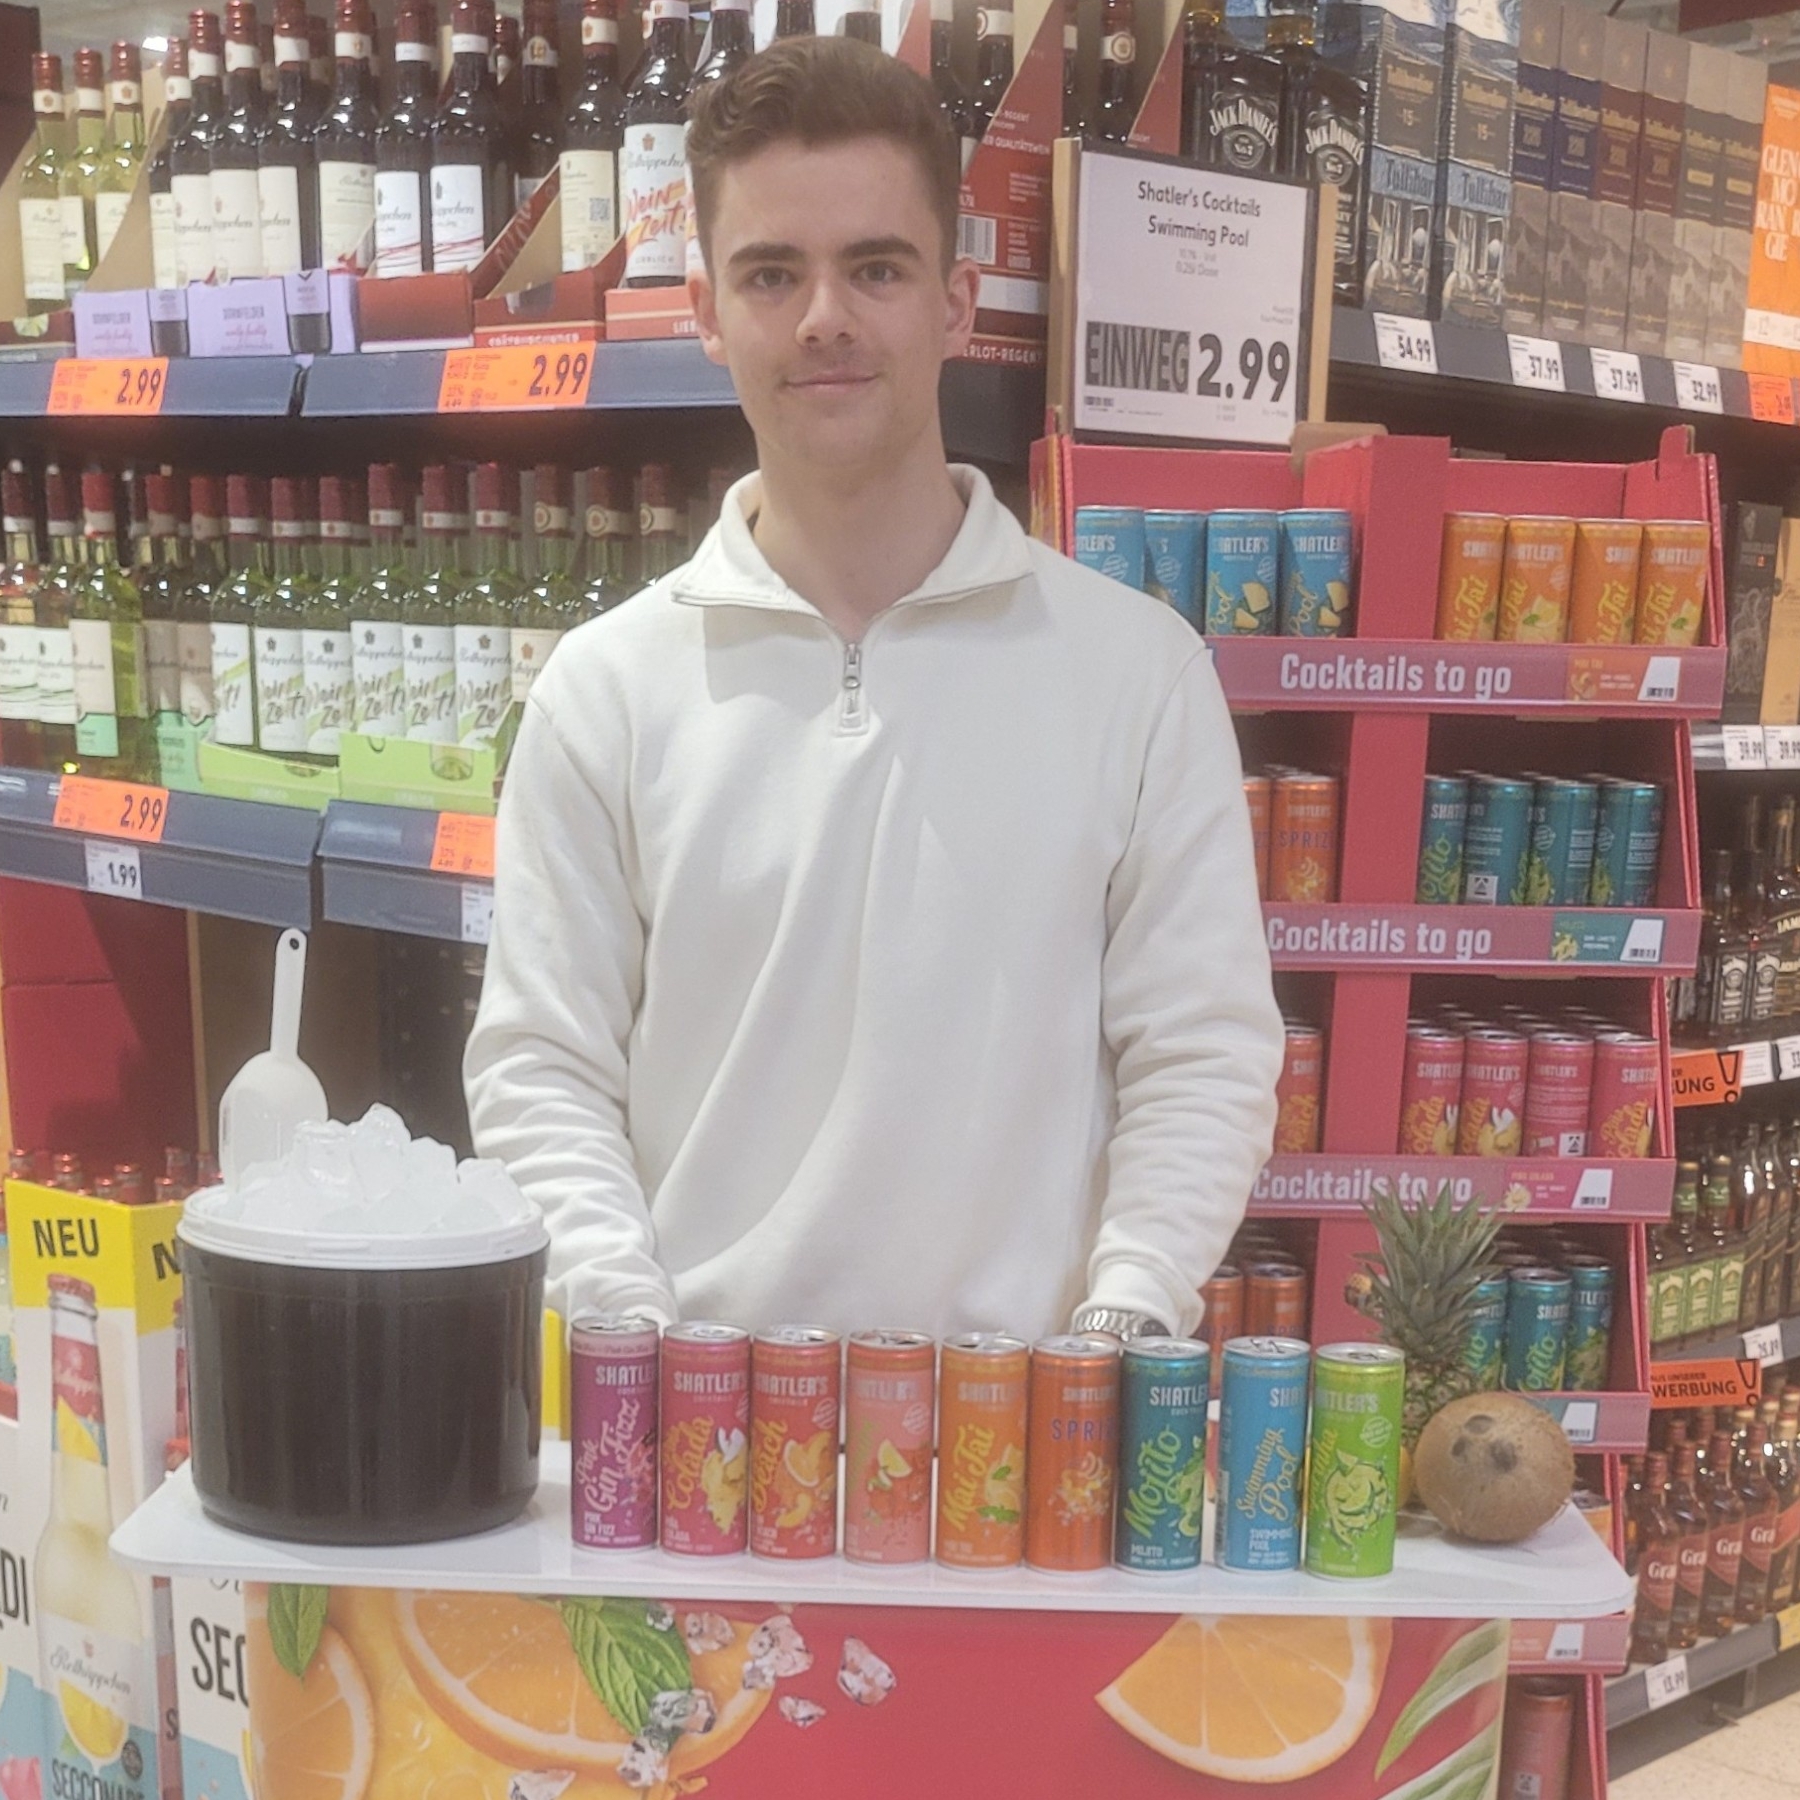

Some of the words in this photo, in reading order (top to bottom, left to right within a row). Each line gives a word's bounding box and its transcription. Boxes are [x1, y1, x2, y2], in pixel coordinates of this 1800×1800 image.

[1138, 180, 1198, 208] Shatler's
[1202, 191, 1261, 217] Cocktails
[1148, 215, 1217, 247] Swimming
[1220, 226, 1250, 247] Pool
[528, 352, 588, 397] 2.99
[1084, 321, 1191, 394] EINWEG
[1196, 332, 1291, 403] 2.99
[117, 368, 162, 405] 2.99
[1280, 653, 1424, 692] Cocktails
[1435, 659, 1466, 692] to
[1475, 666, 1512, 701] go
[119, 793, 163, 833] 2.99
[107, 861, 137, 888] 1.99
[1267, 917, 1406, 953] Cocktails
[1417, 922, 1446, 953] to
[1456, 928, 1491, 961] go
[1252, 1168, 1388, 1200] Cocktails
[1398, 1172, 1428, 1201] to
[32, 1218, 100, 1259] NEU
[151, 1240, 182, 1281] N
[1652, 1380, 1738, 1399] WERBUNG
[953, 1421, 996, 1480] Tai
[942, 1470, 979, 1532] Mai
[1124, 1423, 1182, 1539] Mojito
[1258, 1443, 1298, 1523] Pool
[1130, 1543, 1164, 1558] MOJITO
